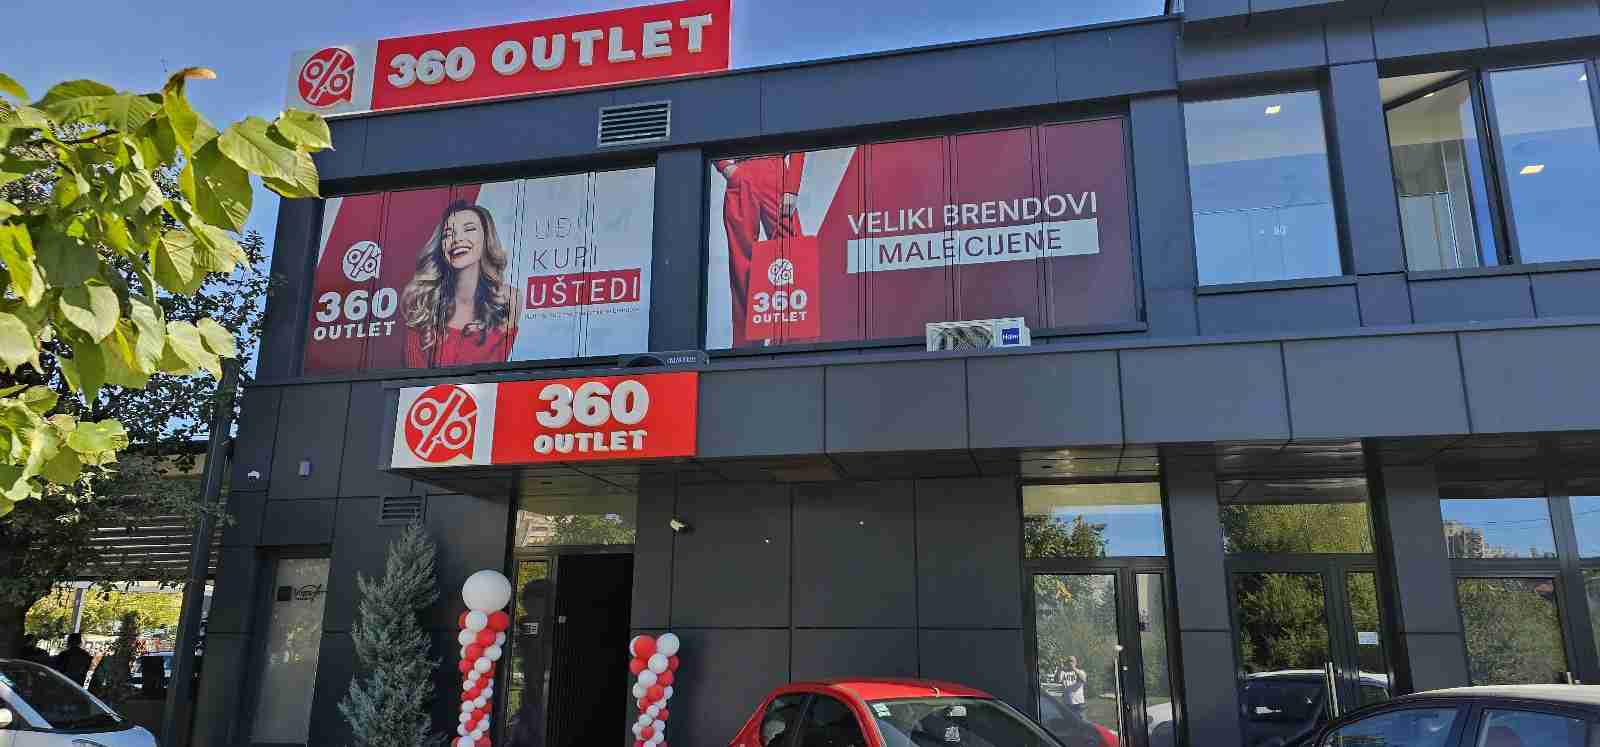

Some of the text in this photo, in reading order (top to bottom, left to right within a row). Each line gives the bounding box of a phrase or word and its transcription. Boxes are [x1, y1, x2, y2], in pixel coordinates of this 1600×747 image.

[387, 13, 713, 88] 360 OUTLET
[847, 192, 1098, 235] VELIKI BRENDOVI
[533, 245, 598, 271] KUPI
[879, 228, 1063, 265] MALE CIJENE
[316, 287, 398, 323] 360
[530, 276, 638, 306] UŠTEDI
[752, 289, 807, 313] 360
[313, 320, 396, 340] OUTLET
[752, 311, 808, 324] OUTLET
[536, 380, 650, 428] 360
[533, 429, 648, 454] OUTLET
